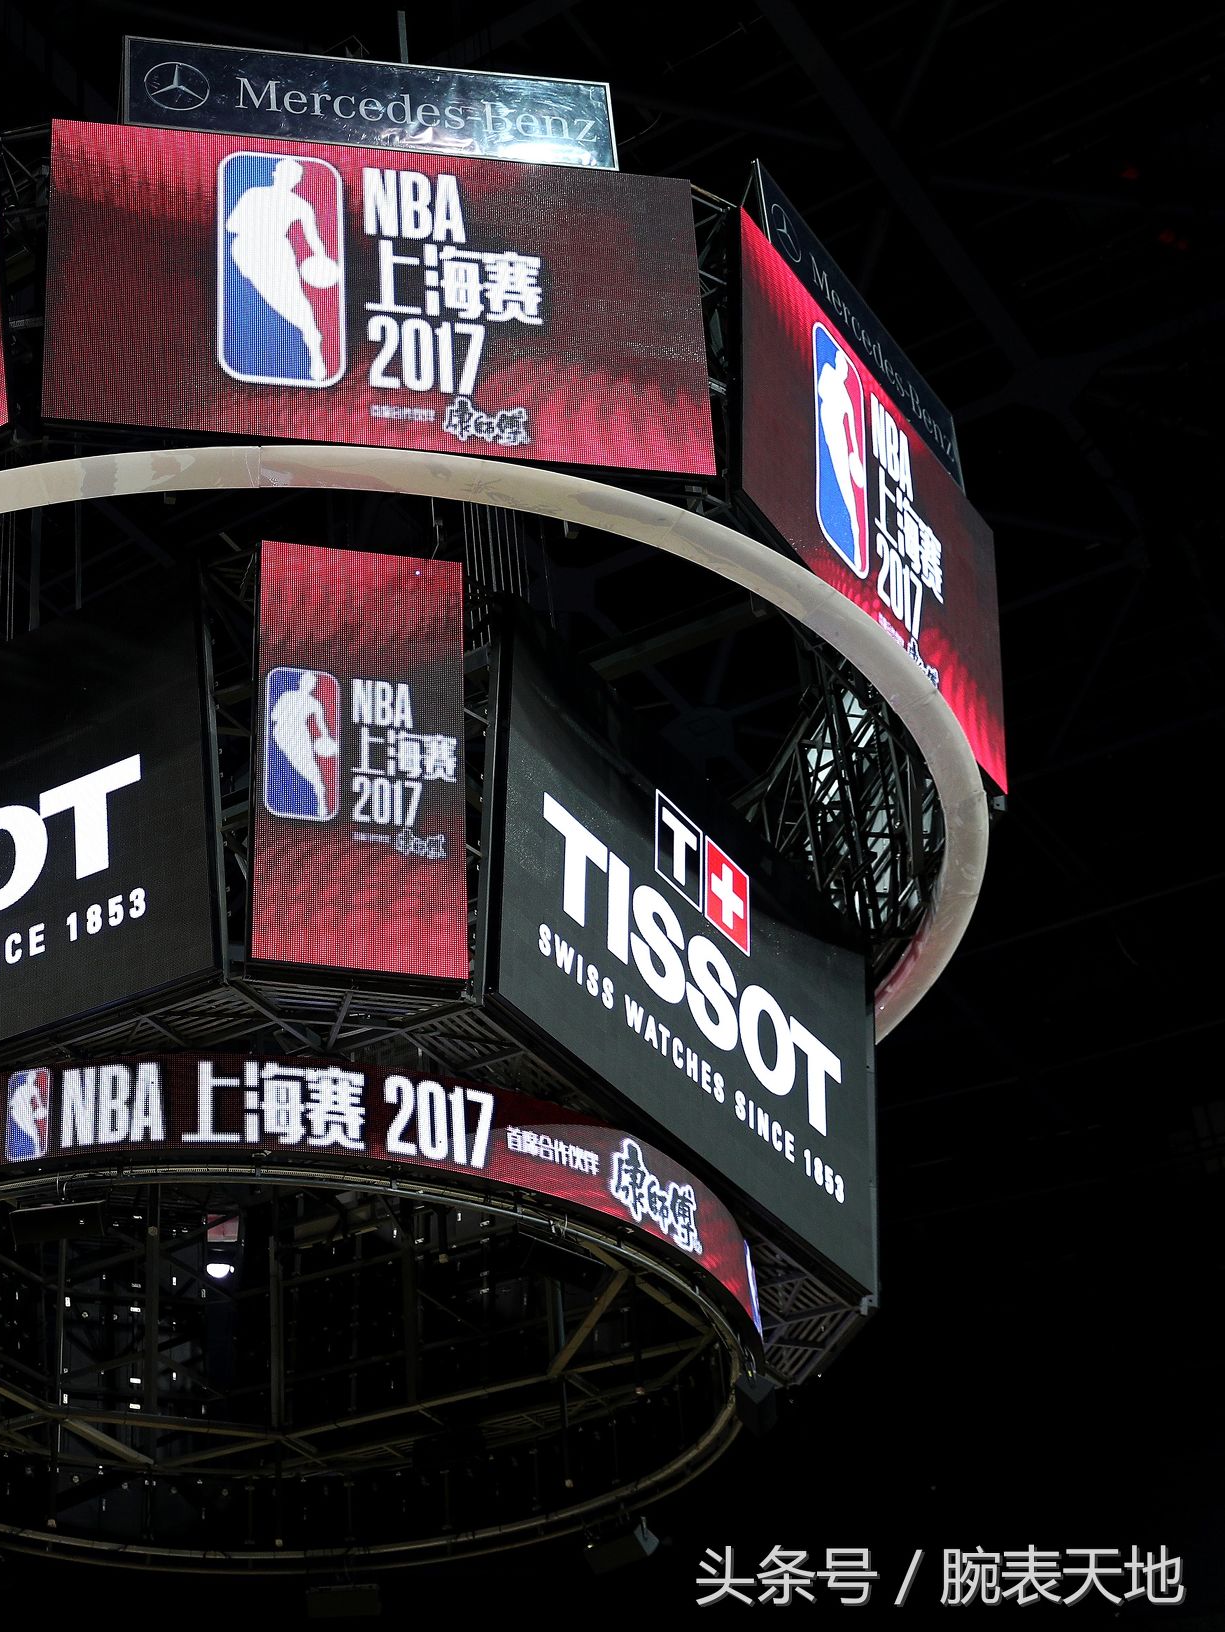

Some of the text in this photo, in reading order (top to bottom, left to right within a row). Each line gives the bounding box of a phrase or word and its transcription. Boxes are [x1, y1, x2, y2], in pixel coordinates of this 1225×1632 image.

[234, 76, 599, 143] Mercedes-Benz
[363, 167, 466, 244] NBA
[365, 240, 543, 326] 上海赛
[368, 317, 486, 396] 2017
[809, 252, 955, 463] Mercedes-Benz
[871, 392, 914, 502] NBA
[875, 466, 944, 604] 上海赛
[876, 533, 923, 641] 2017
[350, 678, 413, 729] NBA
[350, 726, 457, 782] 上海赛
[350, 777, 423, 828] 2017
[66, 887, 147, 942] 1853
[543, 792, 842, 1136] TISSOT
[537, 923, 846, 1204] SWISS WATCHES SINCE 1853
[60, 1060, 494, 1170] NBA 上海赛 2017
